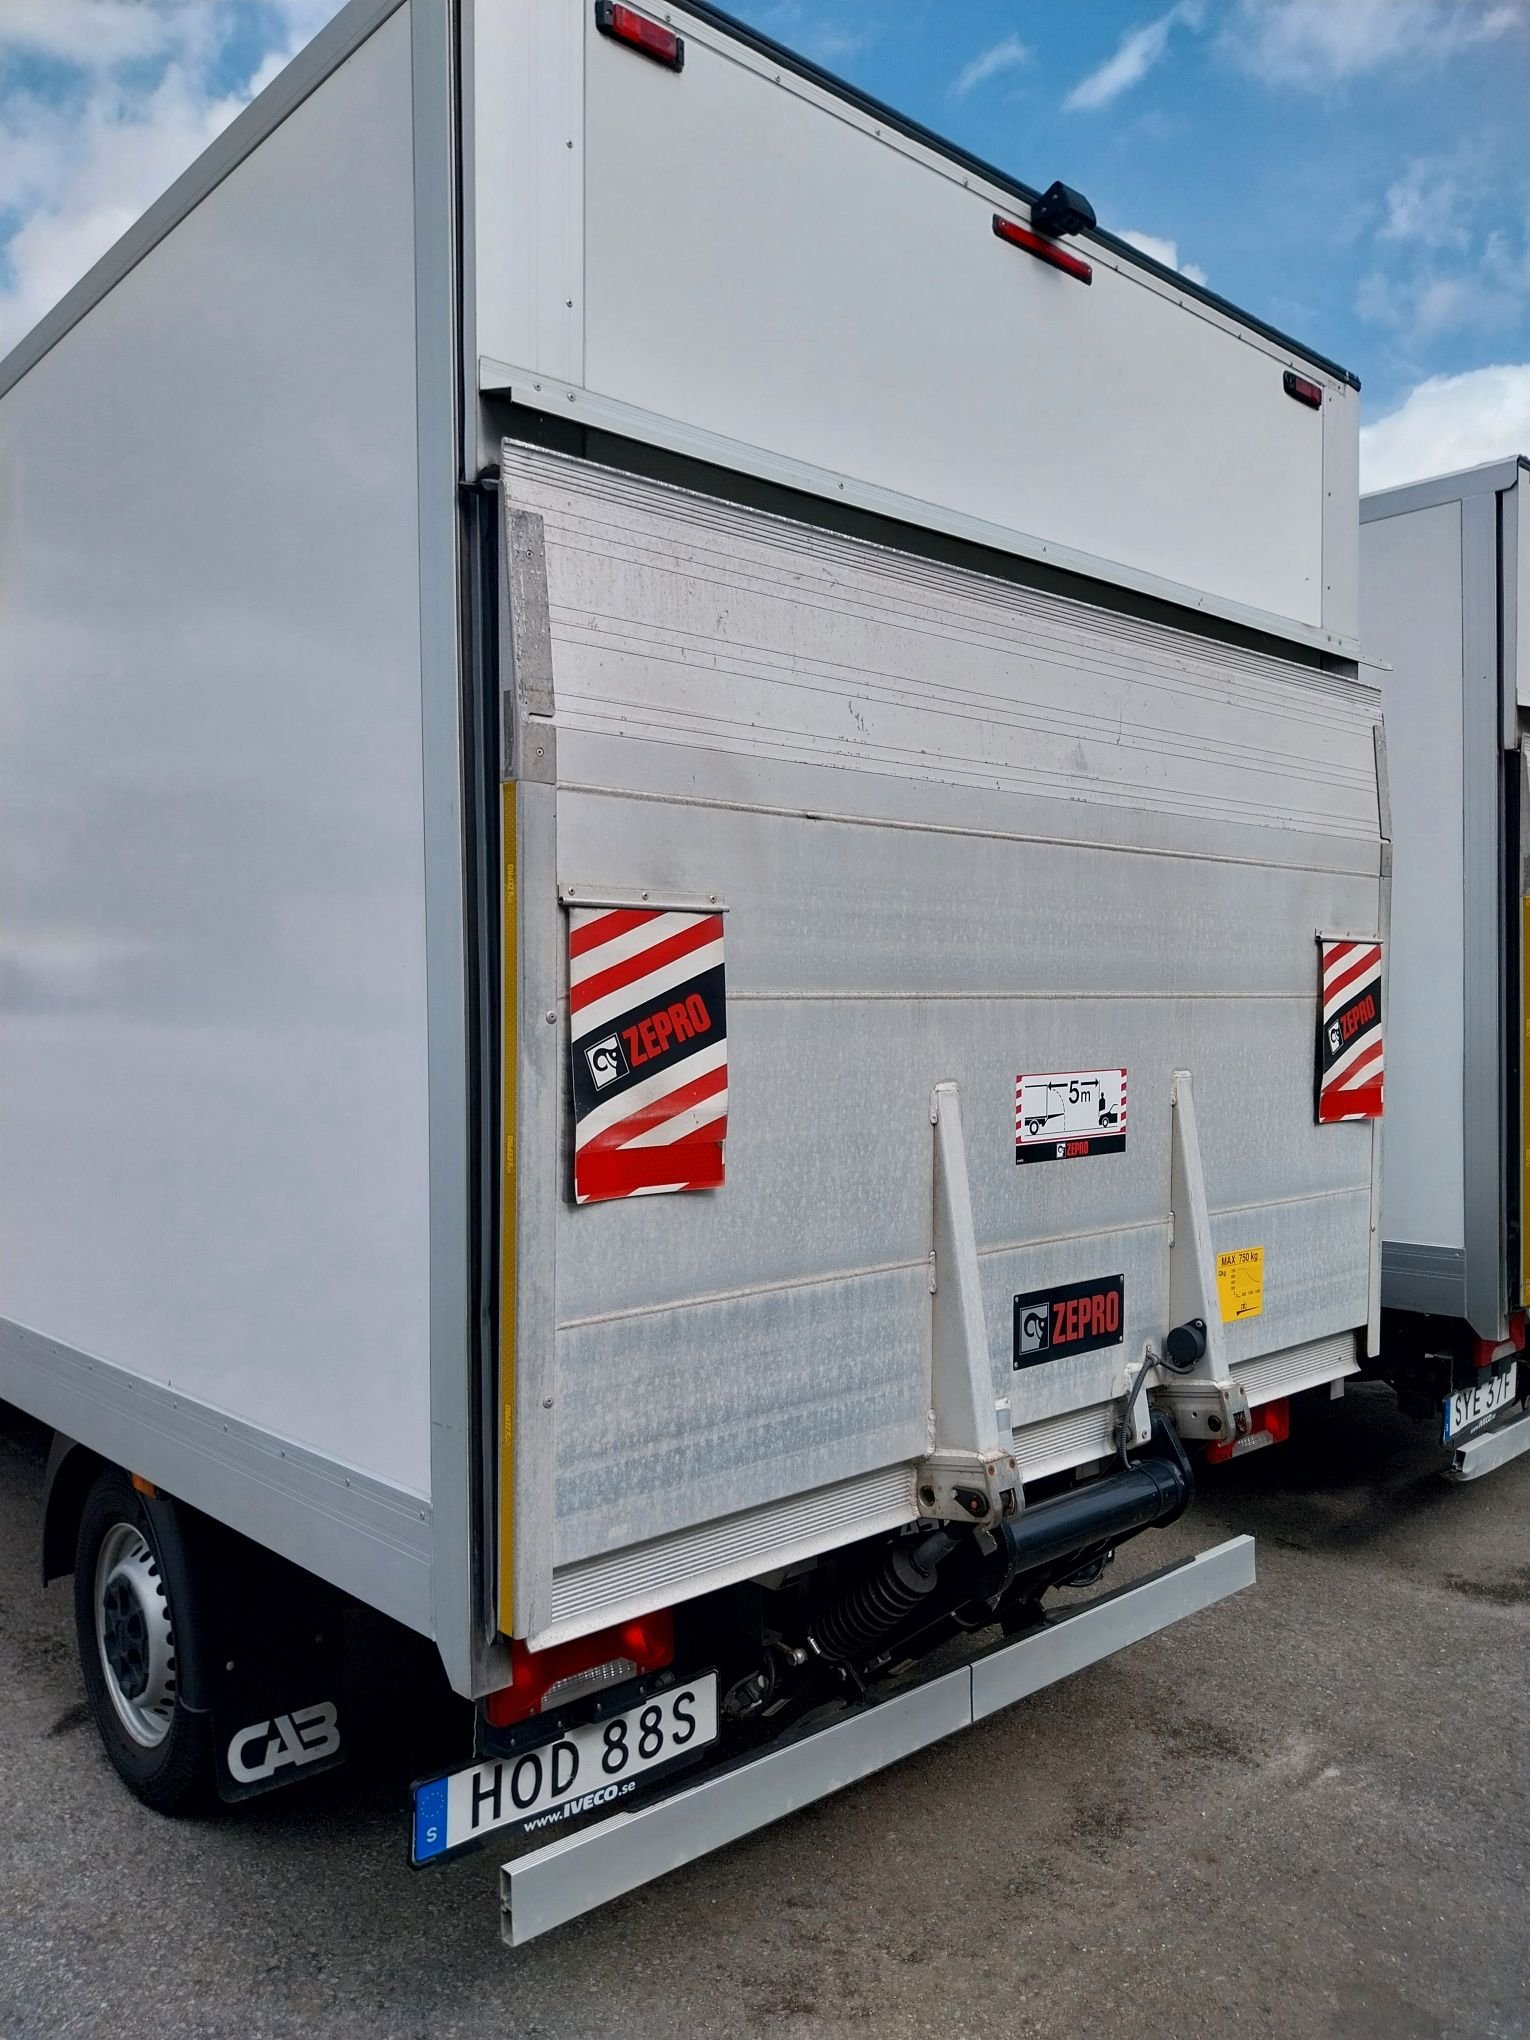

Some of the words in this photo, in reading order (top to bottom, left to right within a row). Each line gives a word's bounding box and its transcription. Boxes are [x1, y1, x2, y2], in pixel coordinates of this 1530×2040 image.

[622, 993, 712, 1069] ZEPRO
[1340, 994, 1376, 1040] ZEPRO
[1067, 1141, 1089, 1156] ZEPRO
[1221, 1255, 1236, 1266] MAX
[1239, 1252, 1250, 1263] 750
[1250, 1251, 1259, 1262] kg
[1053, 1290, 1119, 1345] ZEPRO
[1455, 1387, 1481, 1426] SYE
[227, 1701, 341, 1784] CAB
[471, 1740, 579, 1829] HOD
[601, 1691, 696, 1775] 88S
[523, 1779, 636, 1832] www.IVECO.se
[426, 1826, 438, 1843] S
